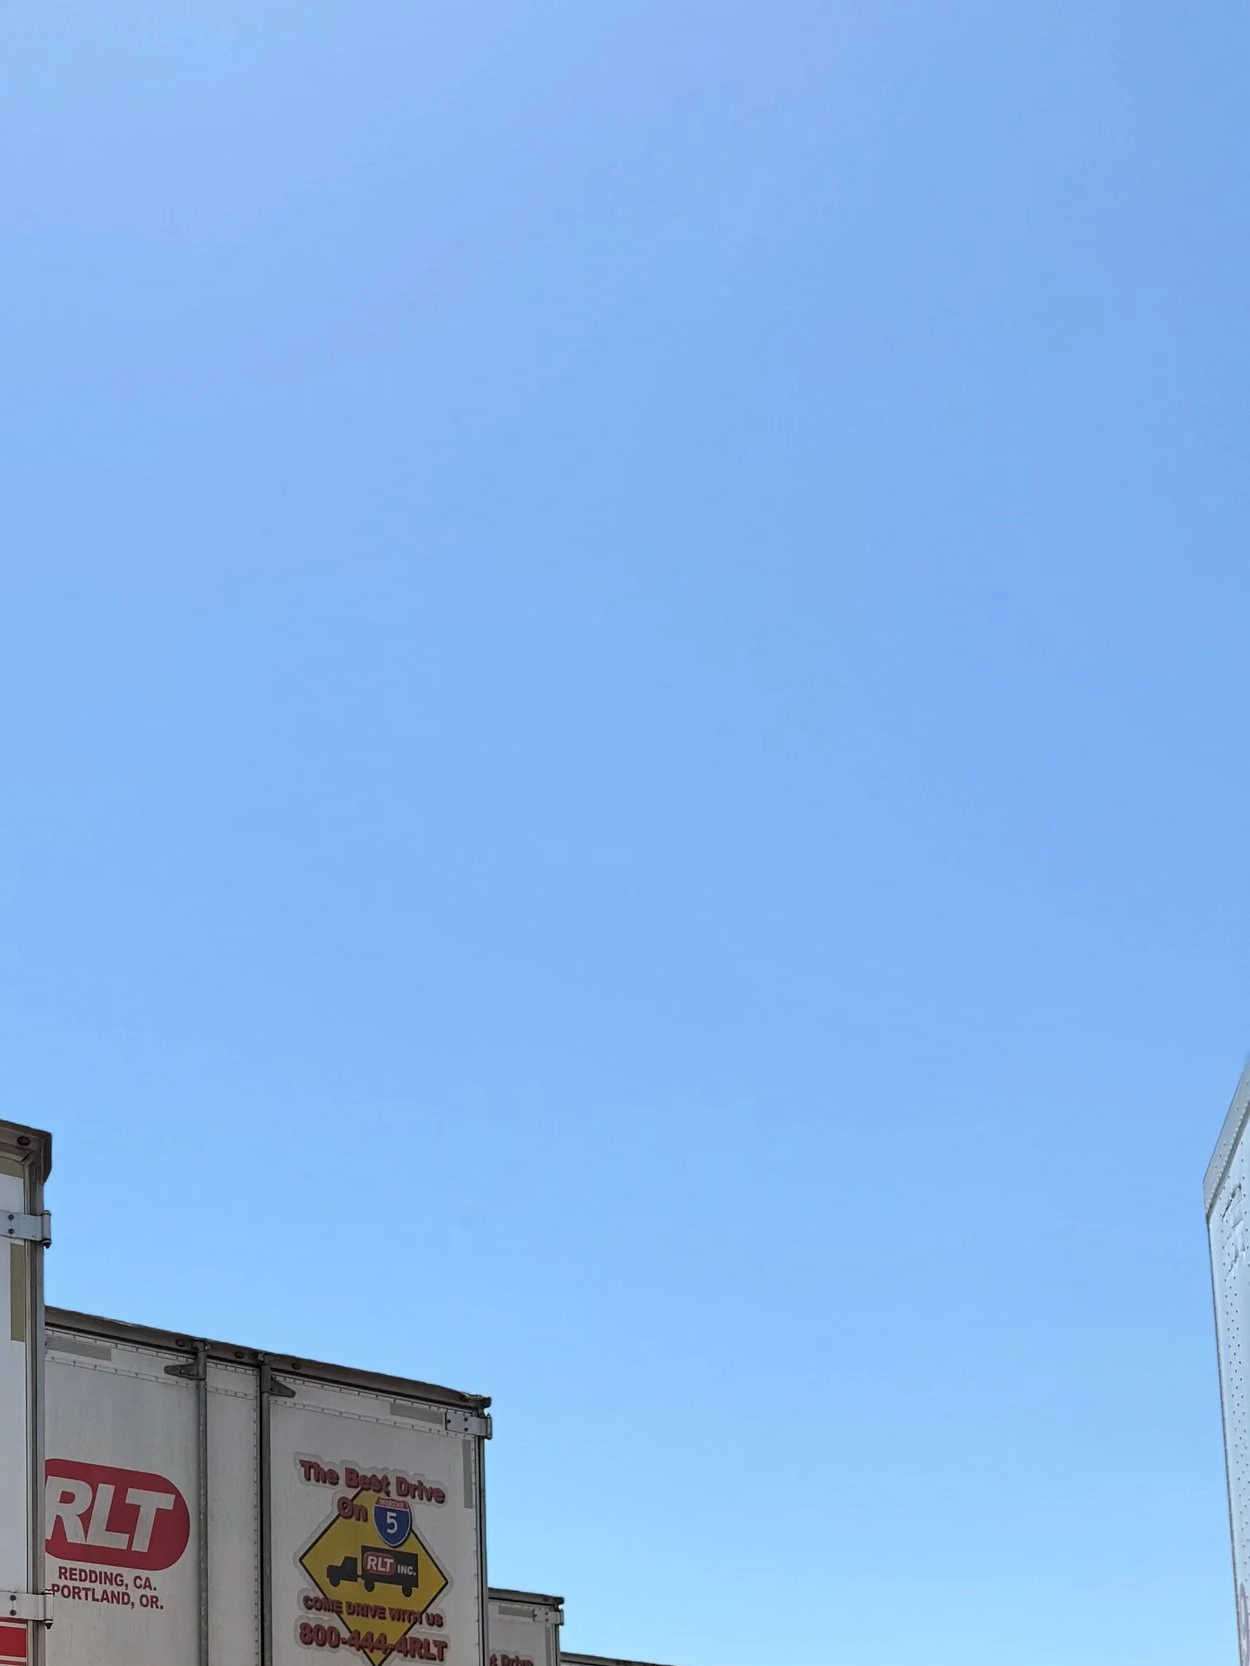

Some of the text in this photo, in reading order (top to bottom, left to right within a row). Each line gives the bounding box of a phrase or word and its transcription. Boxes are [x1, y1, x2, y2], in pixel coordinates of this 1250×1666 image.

[299, 1460, 446, 1504] The Best Drive
[45, 1474, 176, 1553] RLT
[336, 1496, 368, 1522] On
[385, 1511, 398, 1534] 5
[57, 1565, 157, 1591] REDDING, CA.
[366, 1555, 417, 1577] RLT INC.
[52, 1583, 164, 1610] PORTLAND, OR.
[302, 1595, 343, 1614] COME
[345, 1600, 387, 1621] DRIVE
[388, 1606, 424, 1625] WITH
[299, 1622, 448, 1662] 800-444-4RLT
